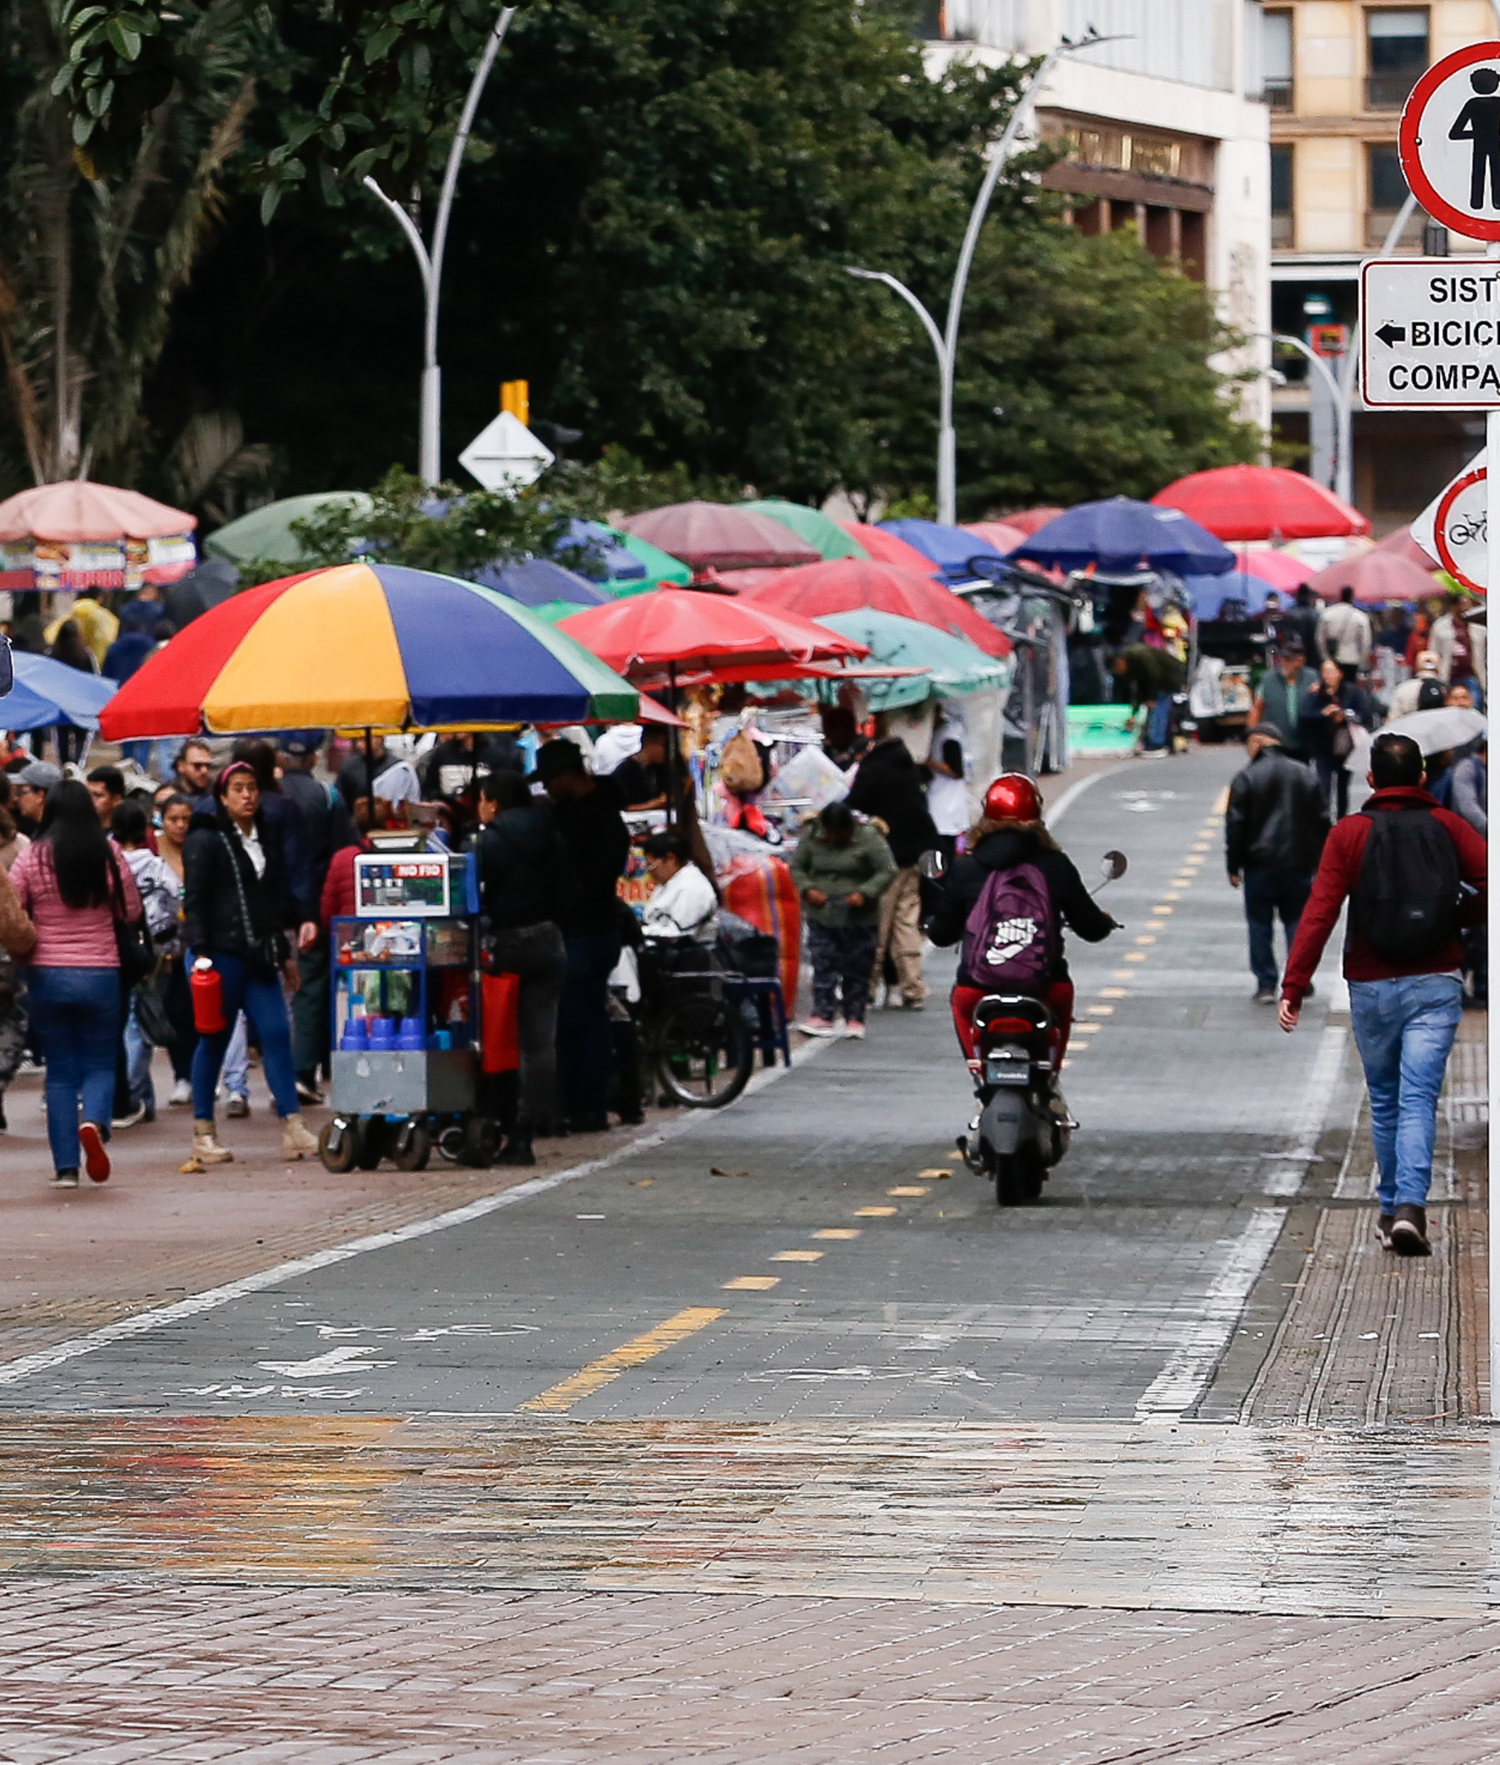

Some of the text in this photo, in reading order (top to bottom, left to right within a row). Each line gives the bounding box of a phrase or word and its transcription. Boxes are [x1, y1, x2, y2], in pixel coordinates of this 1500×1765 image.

[1429, 277, 1498, 302] SIST
[1411, 320, 1500, 346] BICIC
[1388, 364, 1500, 390] COMPA
